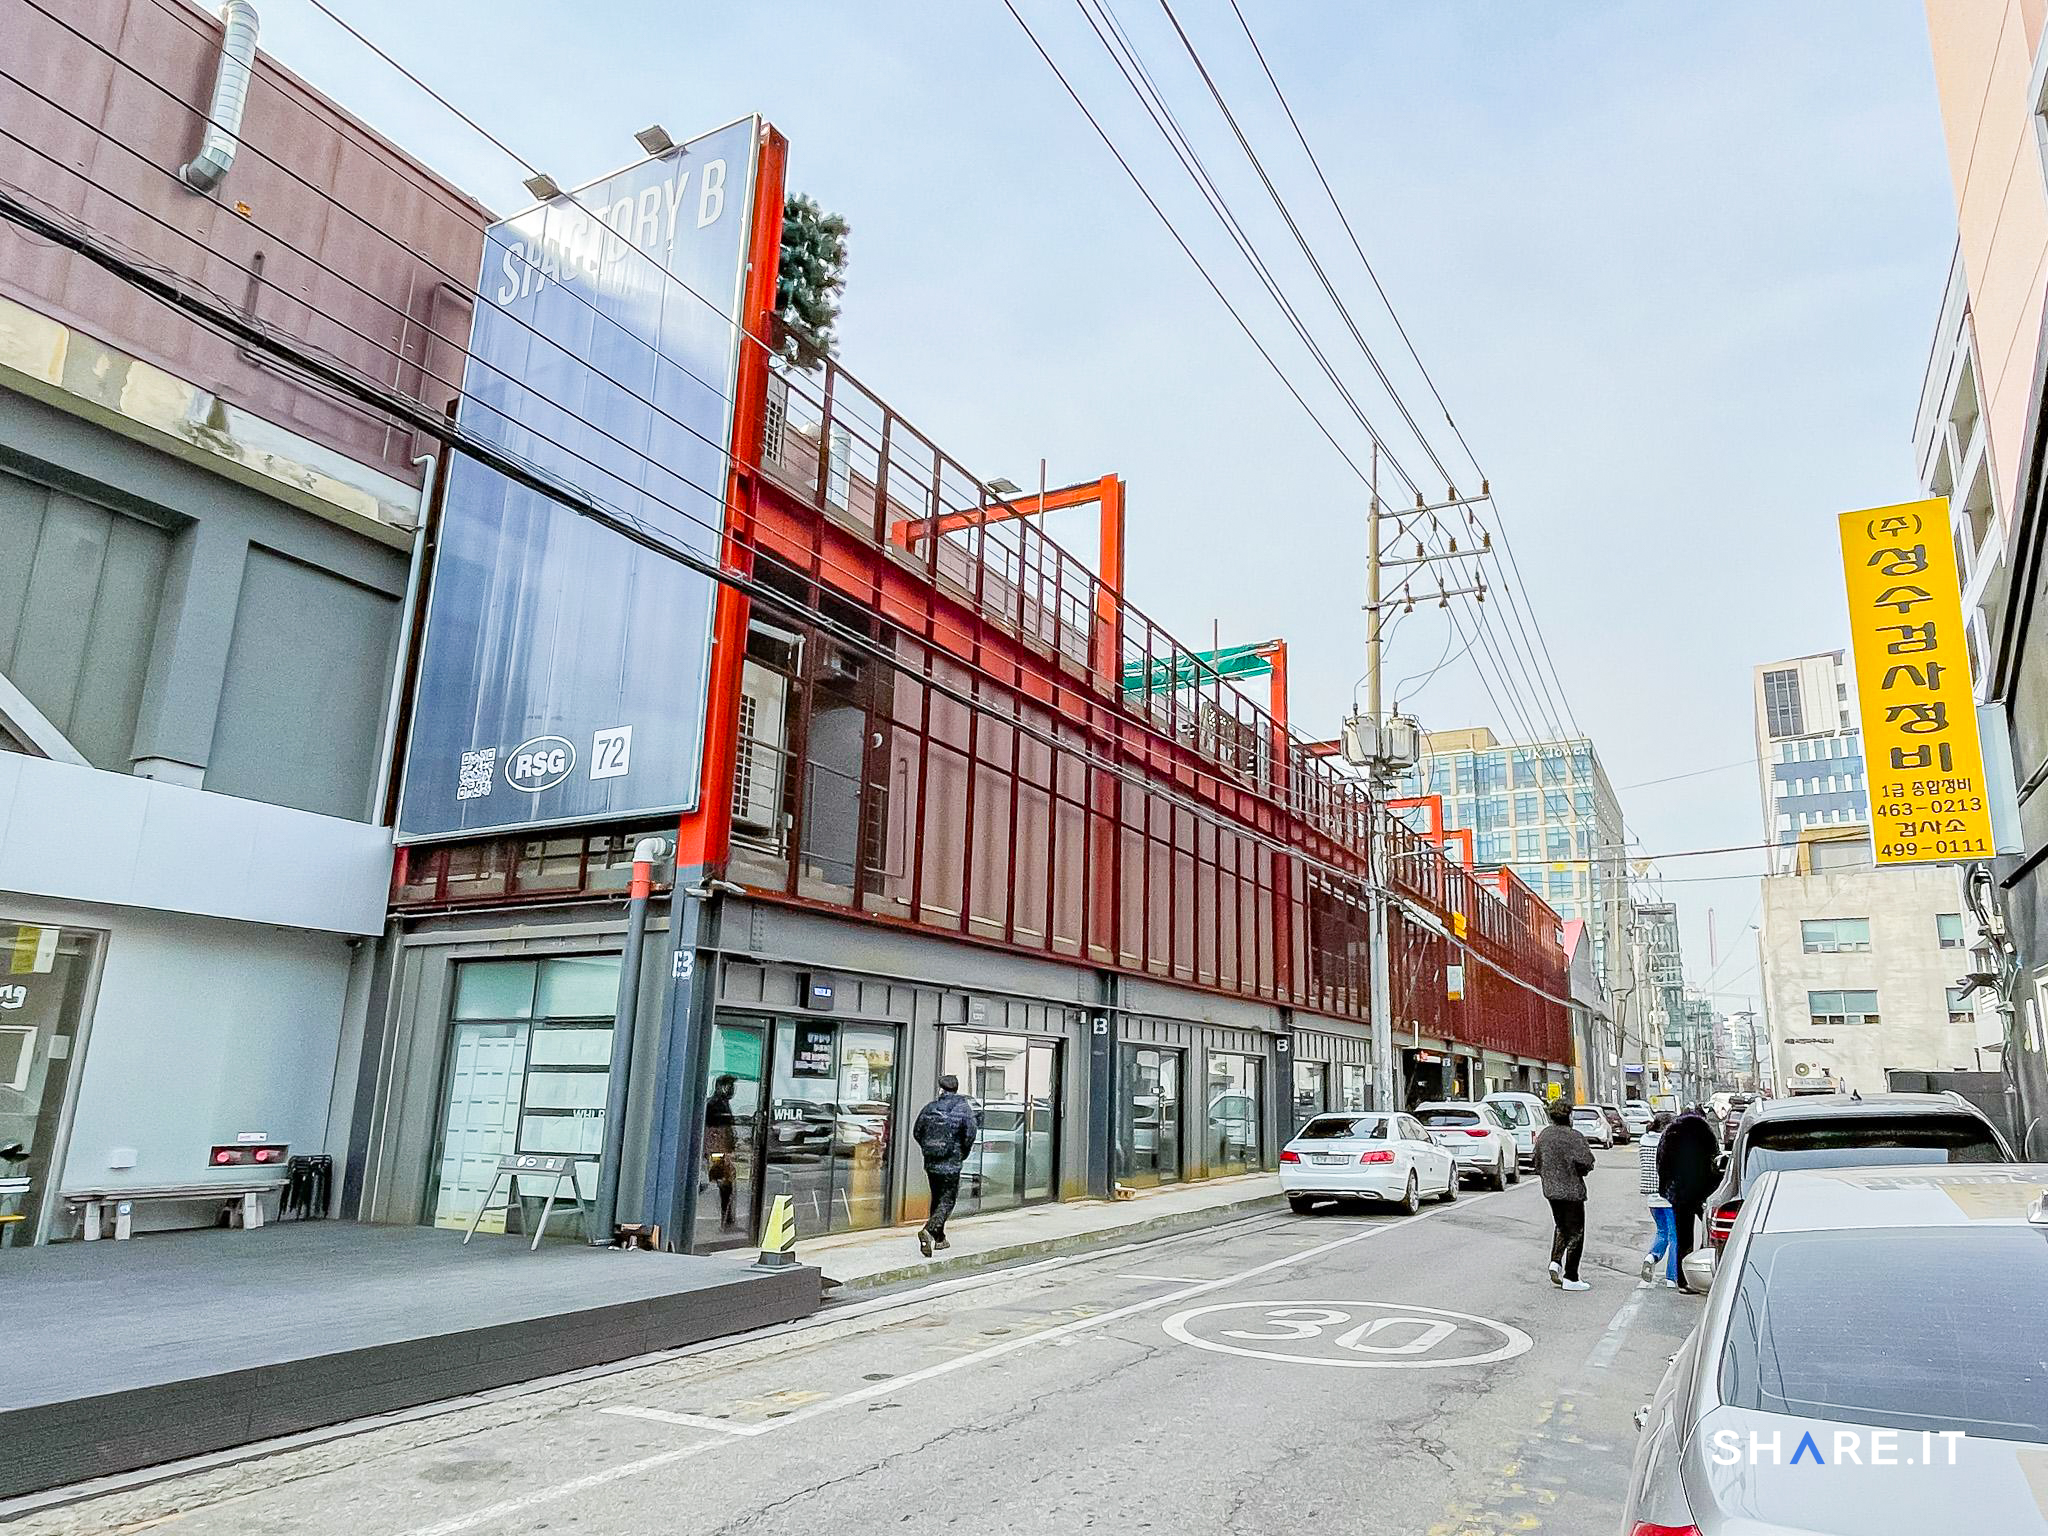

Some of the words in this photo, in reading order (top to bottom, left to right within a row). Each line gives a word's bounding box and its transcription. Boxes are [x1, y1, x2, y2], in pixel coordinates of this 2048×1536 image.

[696, 158, 728, 229] B
[598, 736, 625, 770] 72
[514, 748, 566, 780] RSG
[1876, 797, 1982, 818] 463-0213
[1895, 819, 1967, 838] 검사소
[1881, 838, 1988, 857] 499-0111
[1093, 1017, 1108, 1035] B
[1276, 1038, 1289, 1052] B
[774, 1108, 803, 1121] WHLR
[1219, 1307, 1458, 1355] 30
